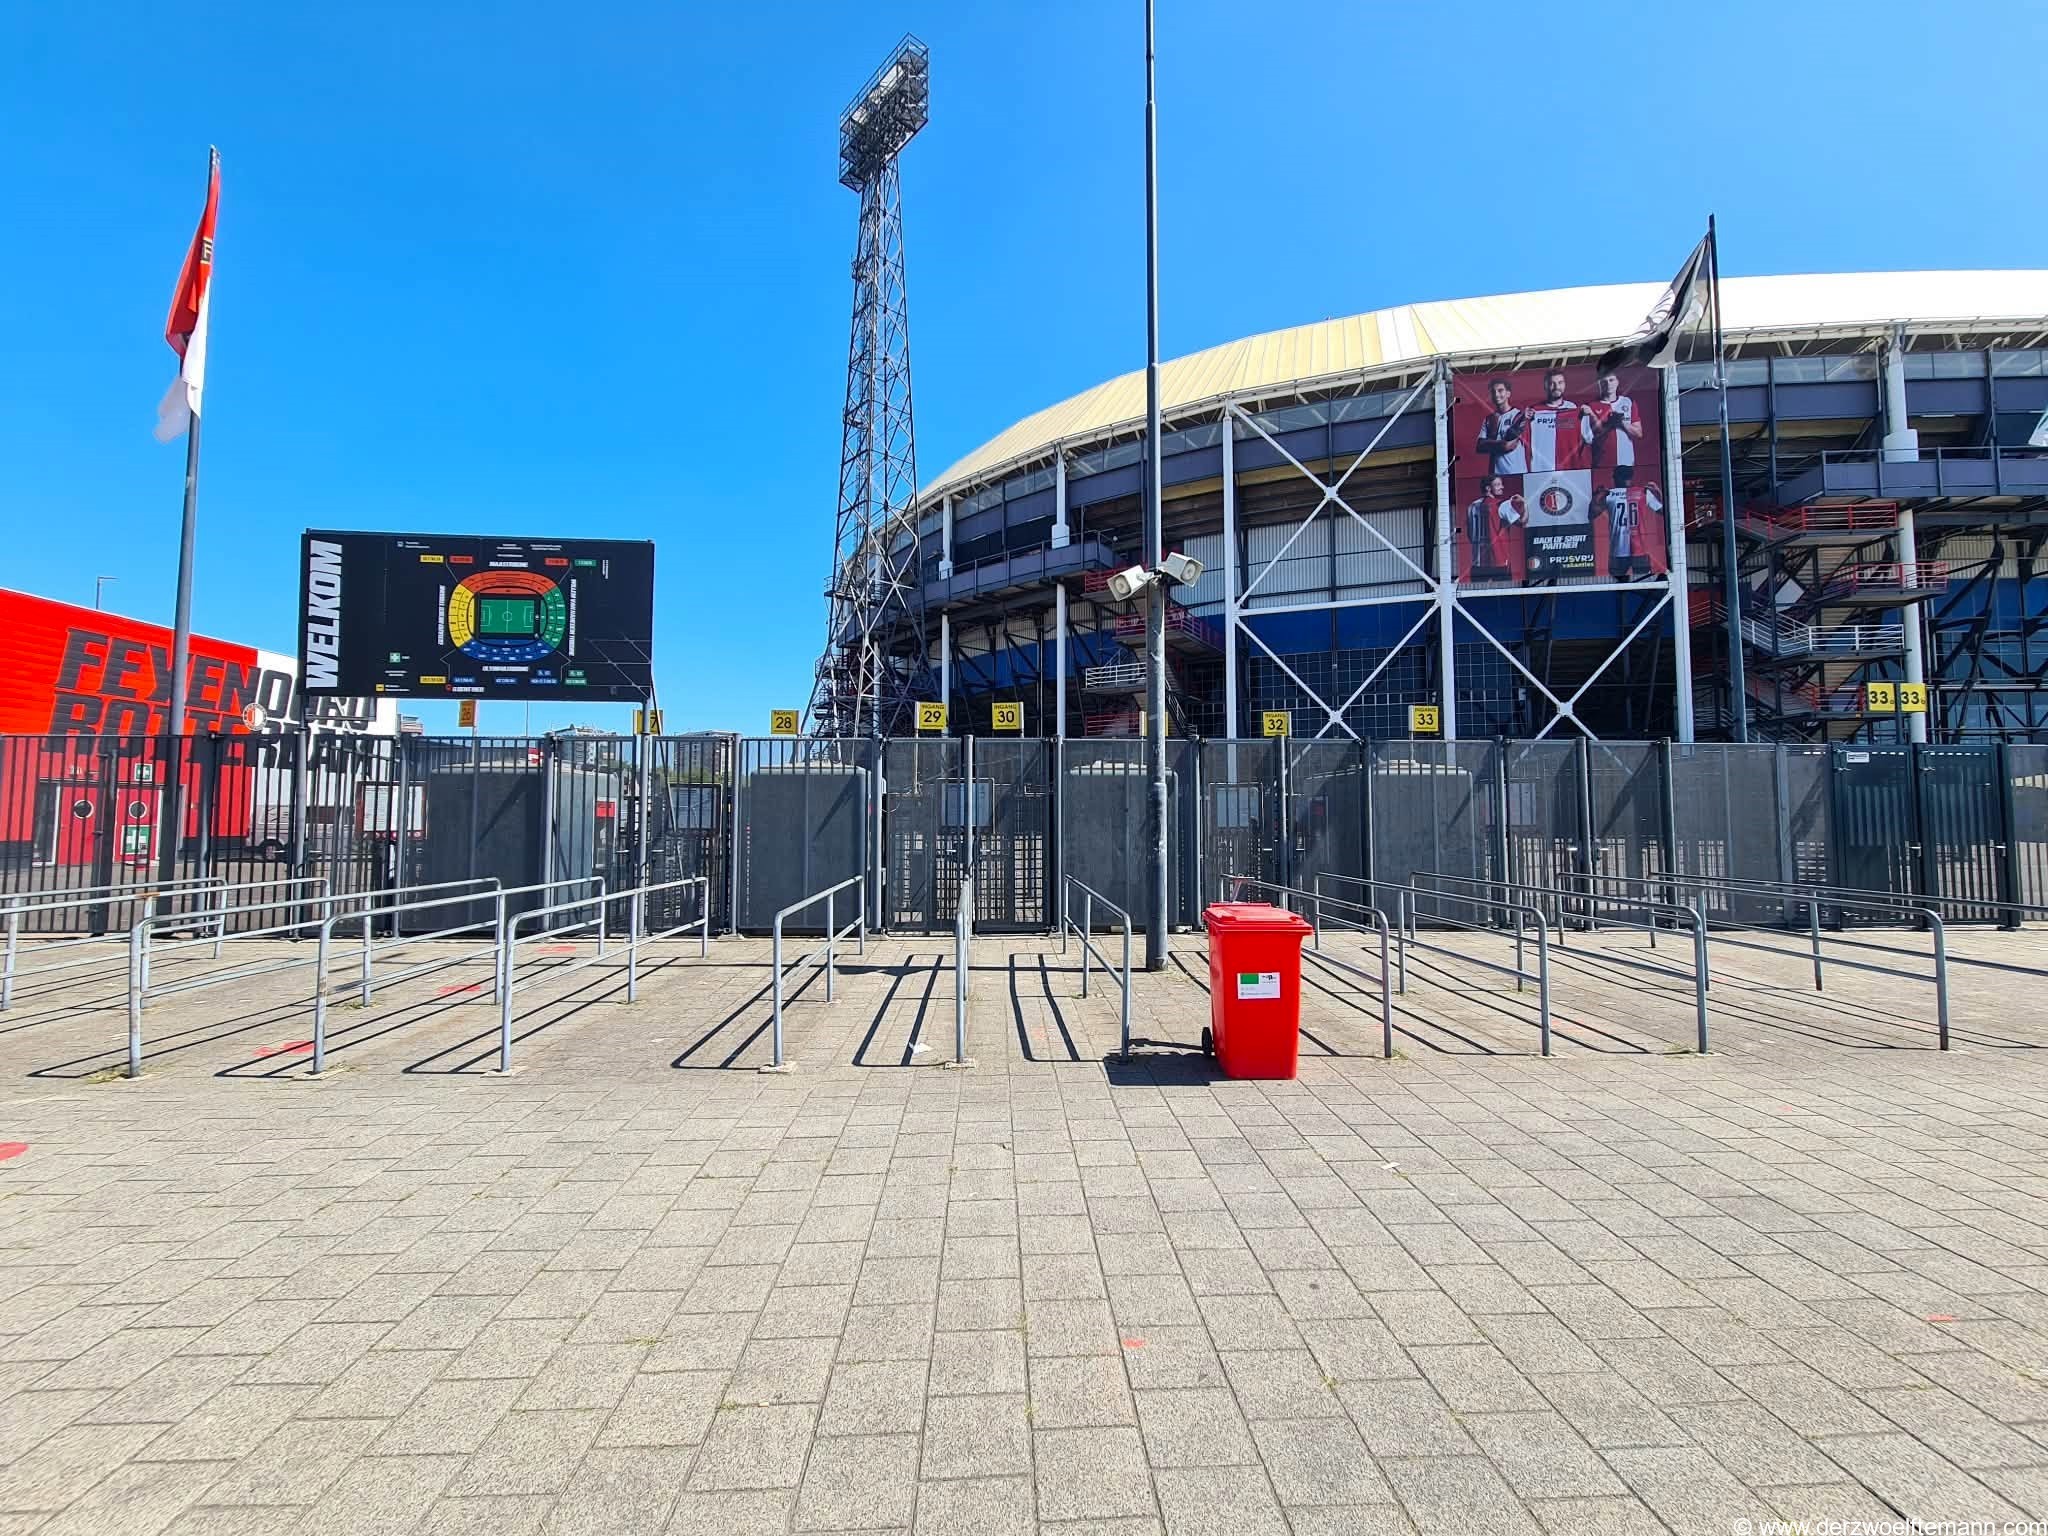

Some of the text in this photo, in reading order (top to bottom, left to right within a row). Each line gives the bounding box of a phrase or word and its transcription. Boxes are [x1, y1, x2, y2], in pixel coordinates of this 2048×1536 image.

[1616, 502, 1638, 526] 26
[1542, 542, 1578, 550] PARTNER
[306, 539, 342, 688] WELKOM
[775, 716, 792, 729] 28
[923, 711, 941, 722] 29
[997, 711, 1015, 723] 30
[1417, 713, 1433, 725] 33
[1268, 718, 1284, 730] 32
